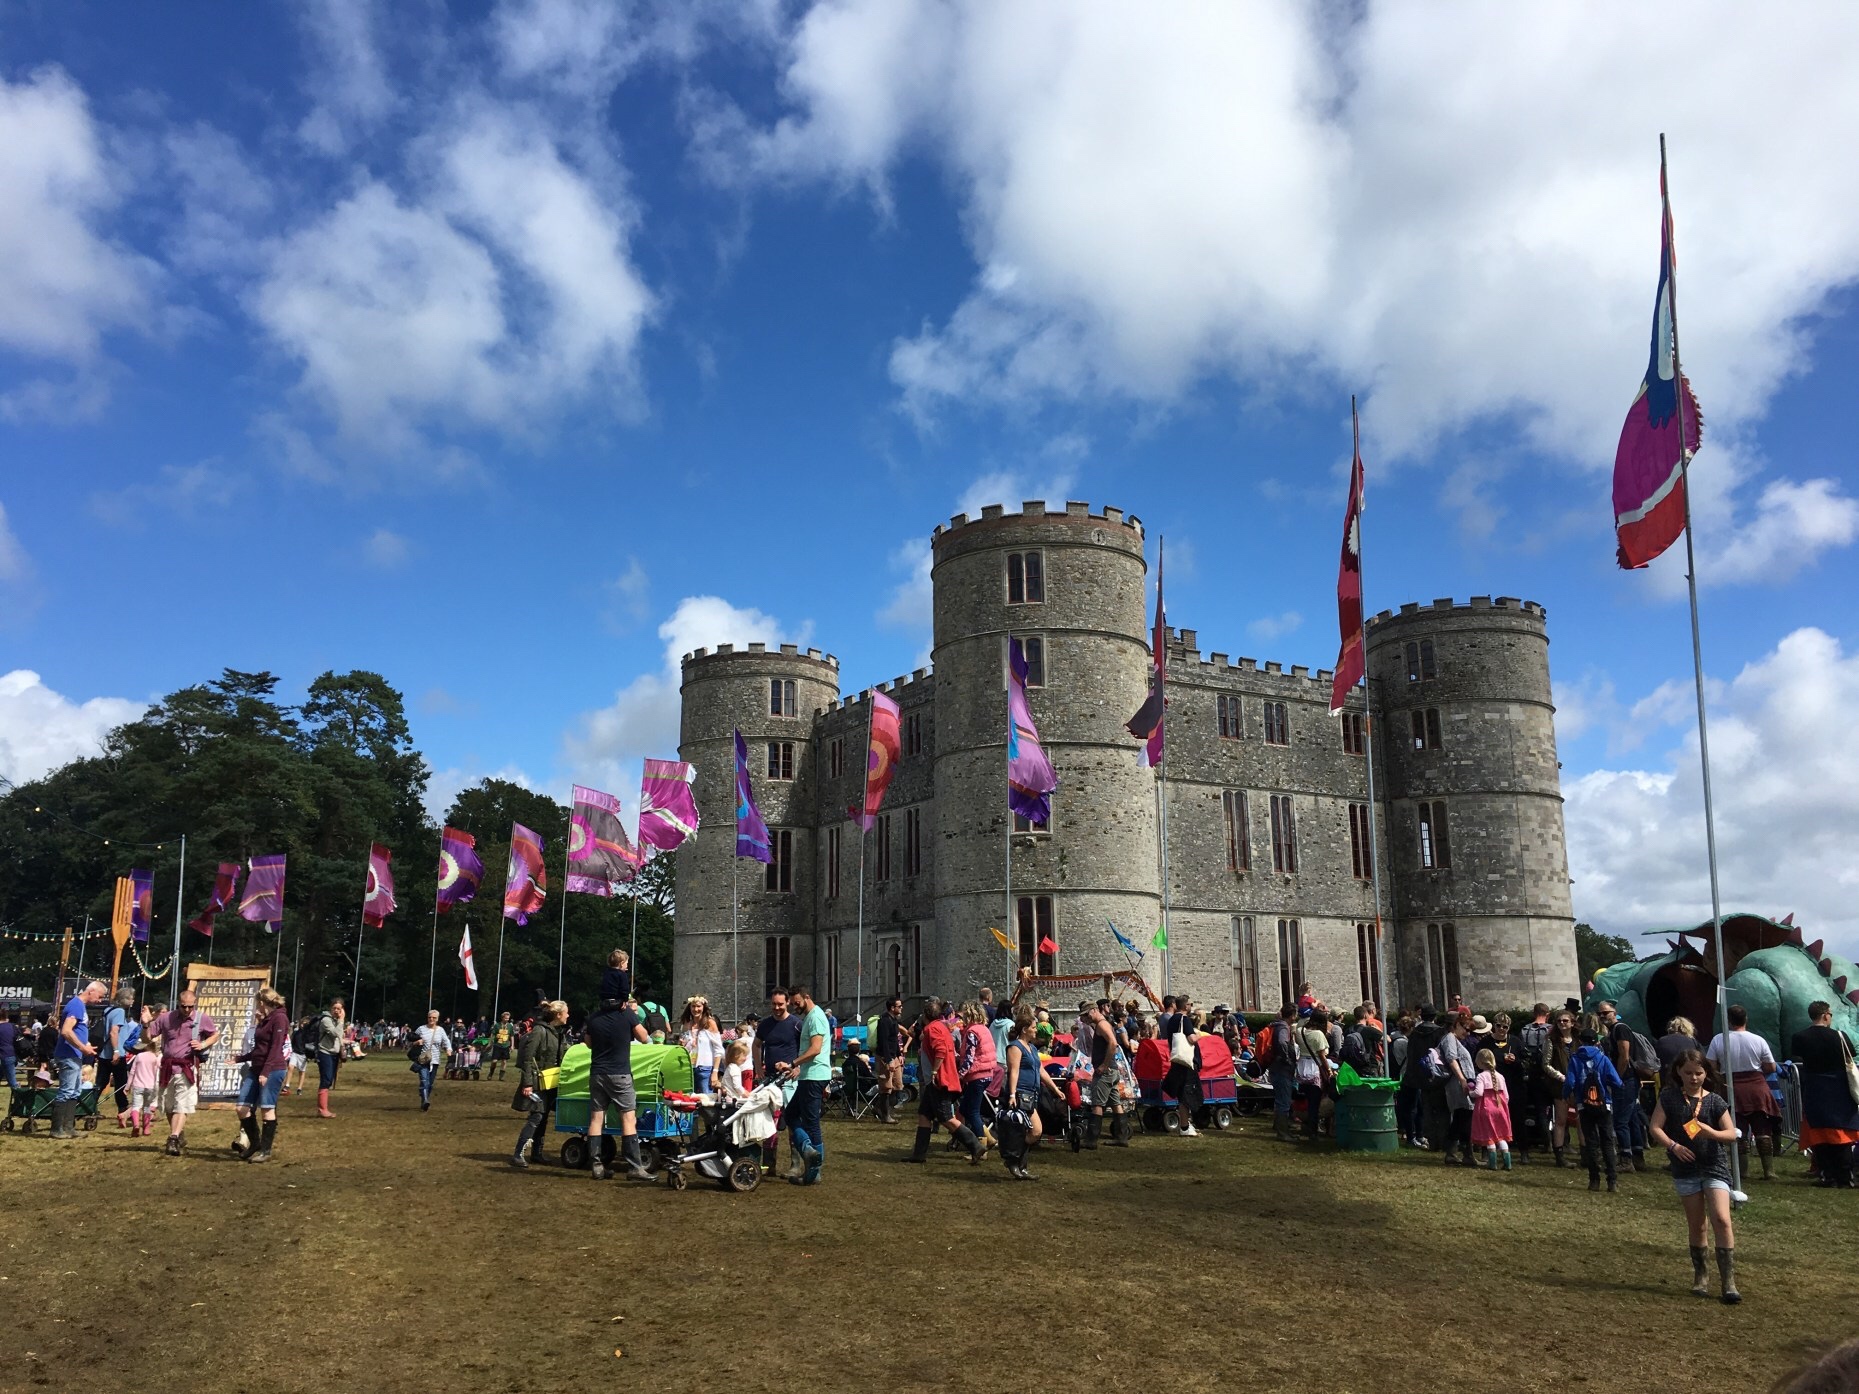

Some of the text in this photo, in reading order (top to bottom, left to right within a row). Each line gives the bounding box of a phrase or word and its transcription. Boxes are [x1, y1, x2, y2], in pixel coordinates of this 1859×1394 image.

[198, 997, 222, 1006] HAPPY
[222, 997, 254, 1006] DJ BBQ
[215, 1069, 225, 1079] LE
